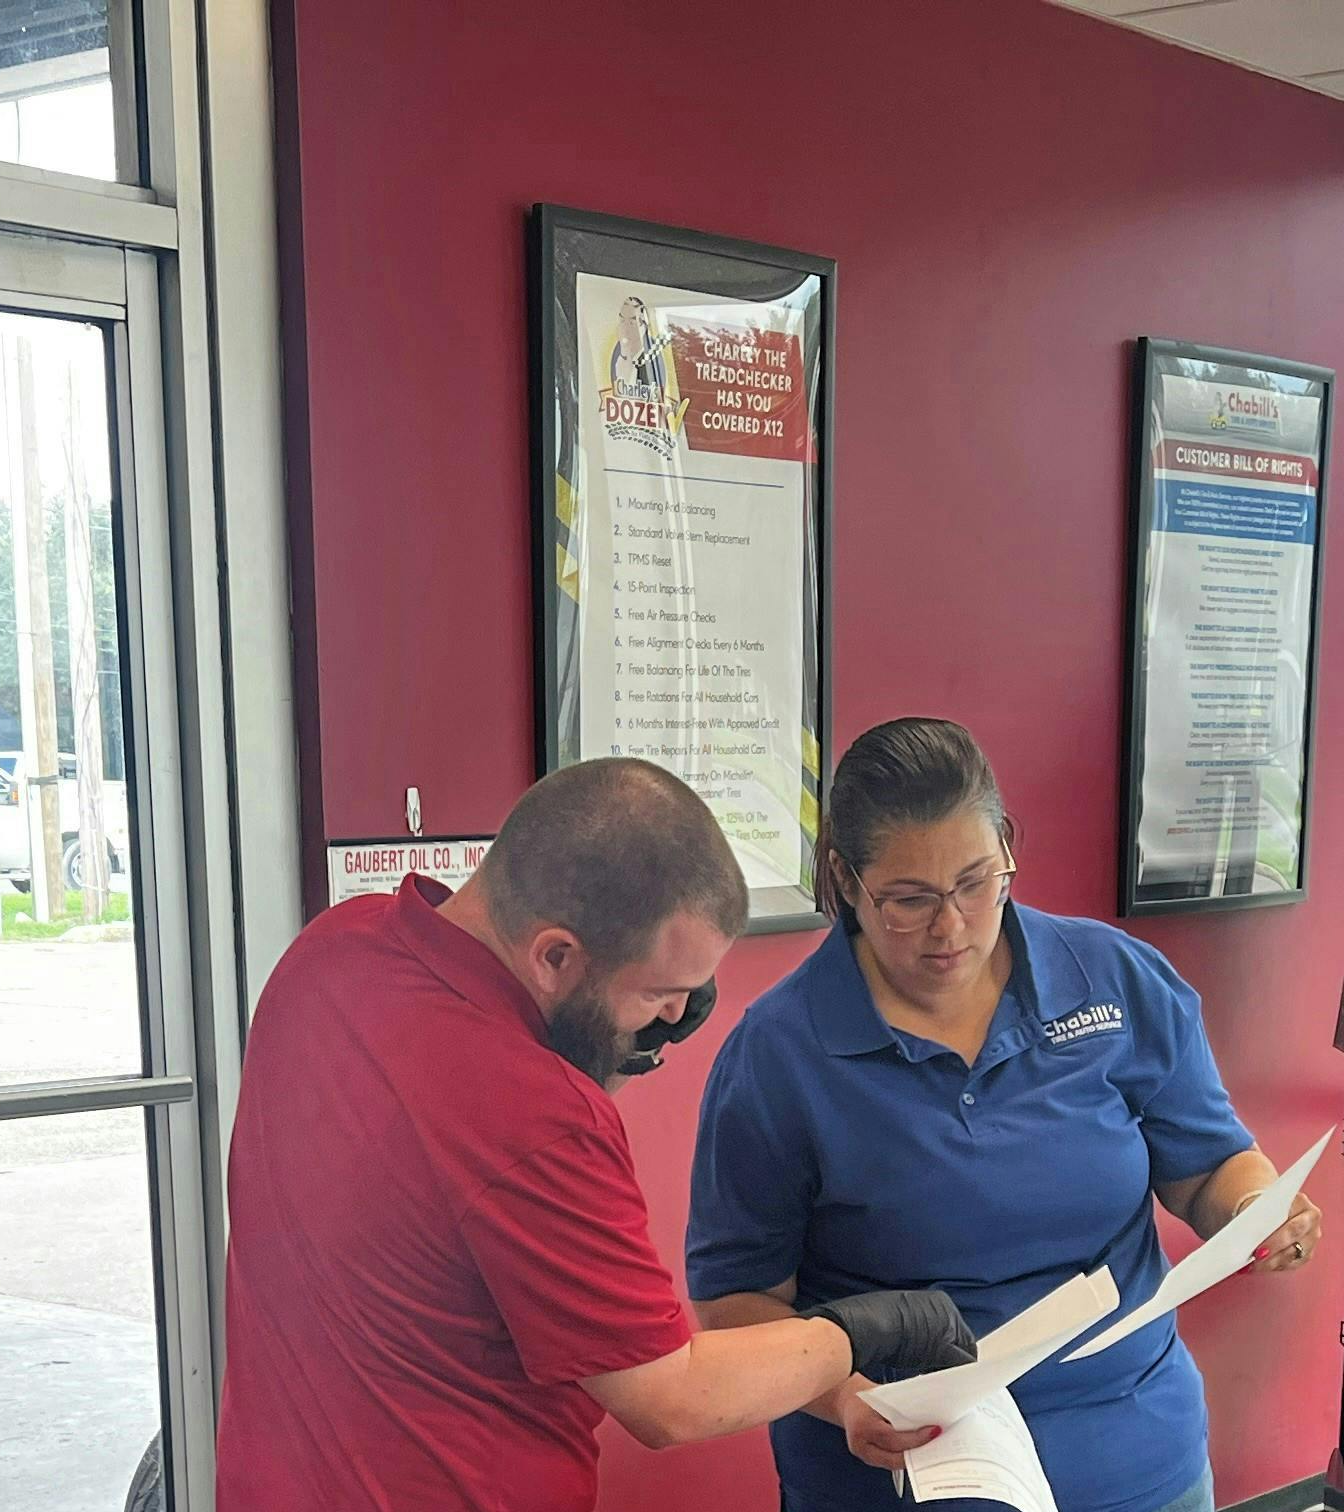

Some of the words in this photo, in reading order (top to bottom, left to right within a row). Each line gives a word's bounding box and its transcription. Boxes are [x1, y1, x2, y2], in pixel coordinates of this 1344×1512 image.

[704, 341, 761, 364] CHARLEY
[764, 349, 787, 368] THE
[696, 362, 792, 393] TREADCHECKER
[717, 390, 742, 408] HAS
[746, 393, 772, 412] YOU
[1228, 392, 1279, 418] Chabill's
[702, 411, 760, 434] COVERED
[763, 419, 784, 437] X12
[1176, 447, 1231, 468] CUSTOMER
[1233, 454, 1253, 471] BILL
[1256, 457, 1270, 473] OF
[1271, 459, 1303, 478] RIGHTS
[628, 498, 664, 515] Mounting
[628, 525, 663, 540] Standard
[704, 531, 751, 546] Replacement
[628, 553, 650, 566] TPMS
[652, 554, 672, 567] Reset
[659, 583, 696, 598] Inspection
[628, 608, 645, 621] Free
[646, 609, 657, 621] Air
[659, 609, 688, 623] Pressure
[690, 610, 716, 624] Checks
[628, 636, 645, 648] Free
[646, 636, 684, 652] Alignment
[714, 638, 732, 653] Every
[733, 639, 739, 650] 6
[739, 640, 765, 652] Months
[628, 663, 645, 676] Free
[646, 664, 683, 679] Balancing
[698, 664, 709, 676] Life
[711, 664, 721, 677] Of
[722, 665, 735, 677] The
[736, 665, 751, 677] Tires
[628, 690, 645, 703] Free
[646, 690, 680, 703] Rotations
[681, 691, 692, 703] For
[705, 691, 742, 703] Household
[743, 692, 759, 703] Cars
[628, 718, 633, 730] 6
[635, 718, 663, 729] Months
[709, 717, 725, 729] With
[726, 718, 760, 733] Approved
[760, 718, 780, 729] Credit
[628, 744, 645, 756] Free
[646, 744, 659, 756] Tire
[689, 744, 701, 756] For
[702, 744, 712, 755] All
[713, 744, 750, 755] Household
[750, 744, 766, 755] Cars
[710, 770, 722, 781] On
[345, 850, 404, 873] GAUBERT
[409, 848, 430, 871] OIL
[1043, 1003, 1122, 1037] Chabill's
